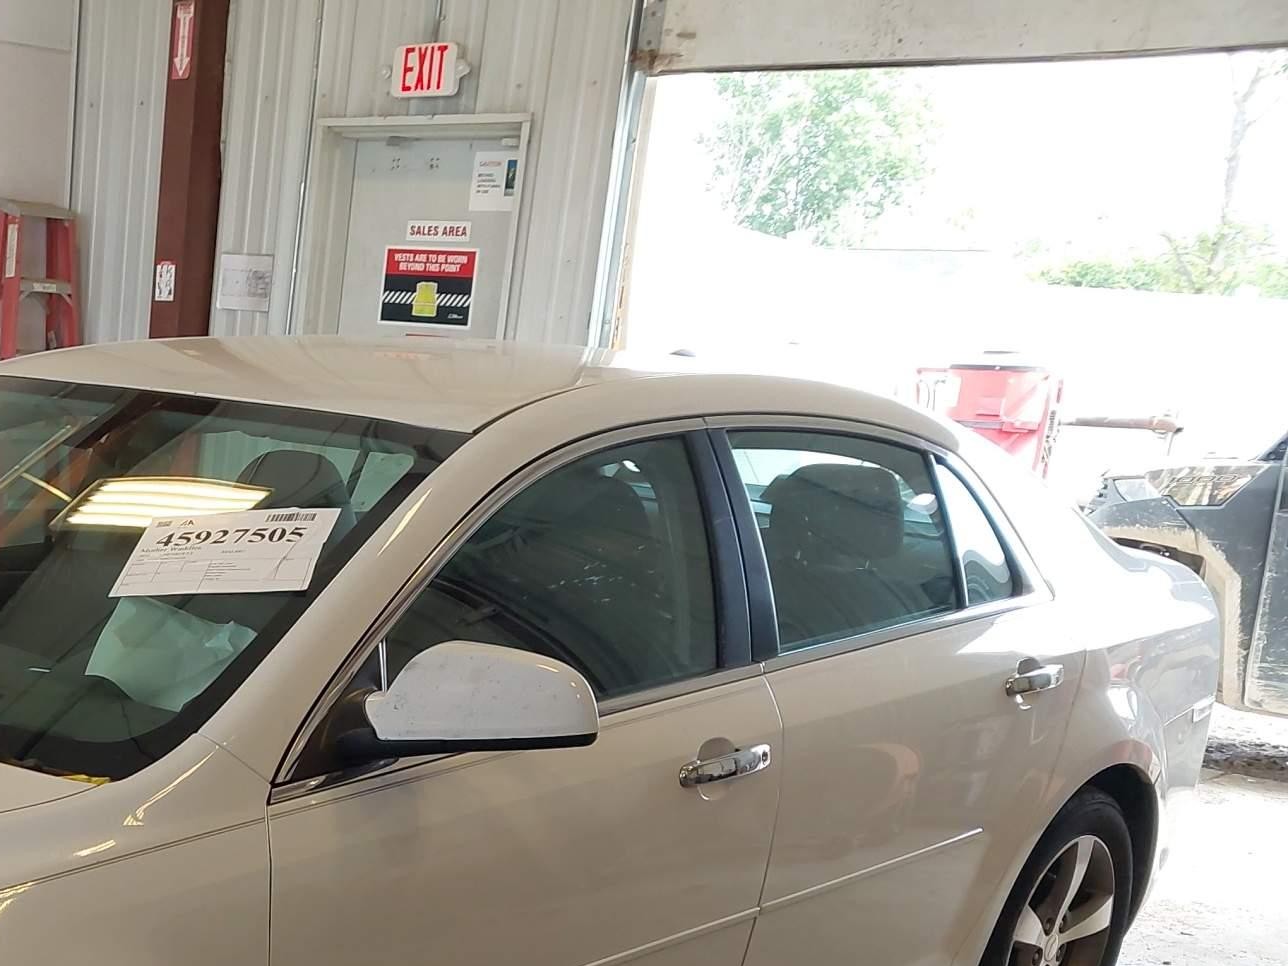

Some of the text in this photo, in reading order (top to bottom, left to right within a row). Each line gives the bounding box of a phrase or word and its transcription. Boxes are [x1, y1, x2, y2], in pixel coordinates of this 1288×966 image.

[401, 45, 448, 91] EXIT
[409, 225, 467, 237] SALES AREA
[428, 254, 437, 263] TO
[156, 527, 307, 547] 45927505
